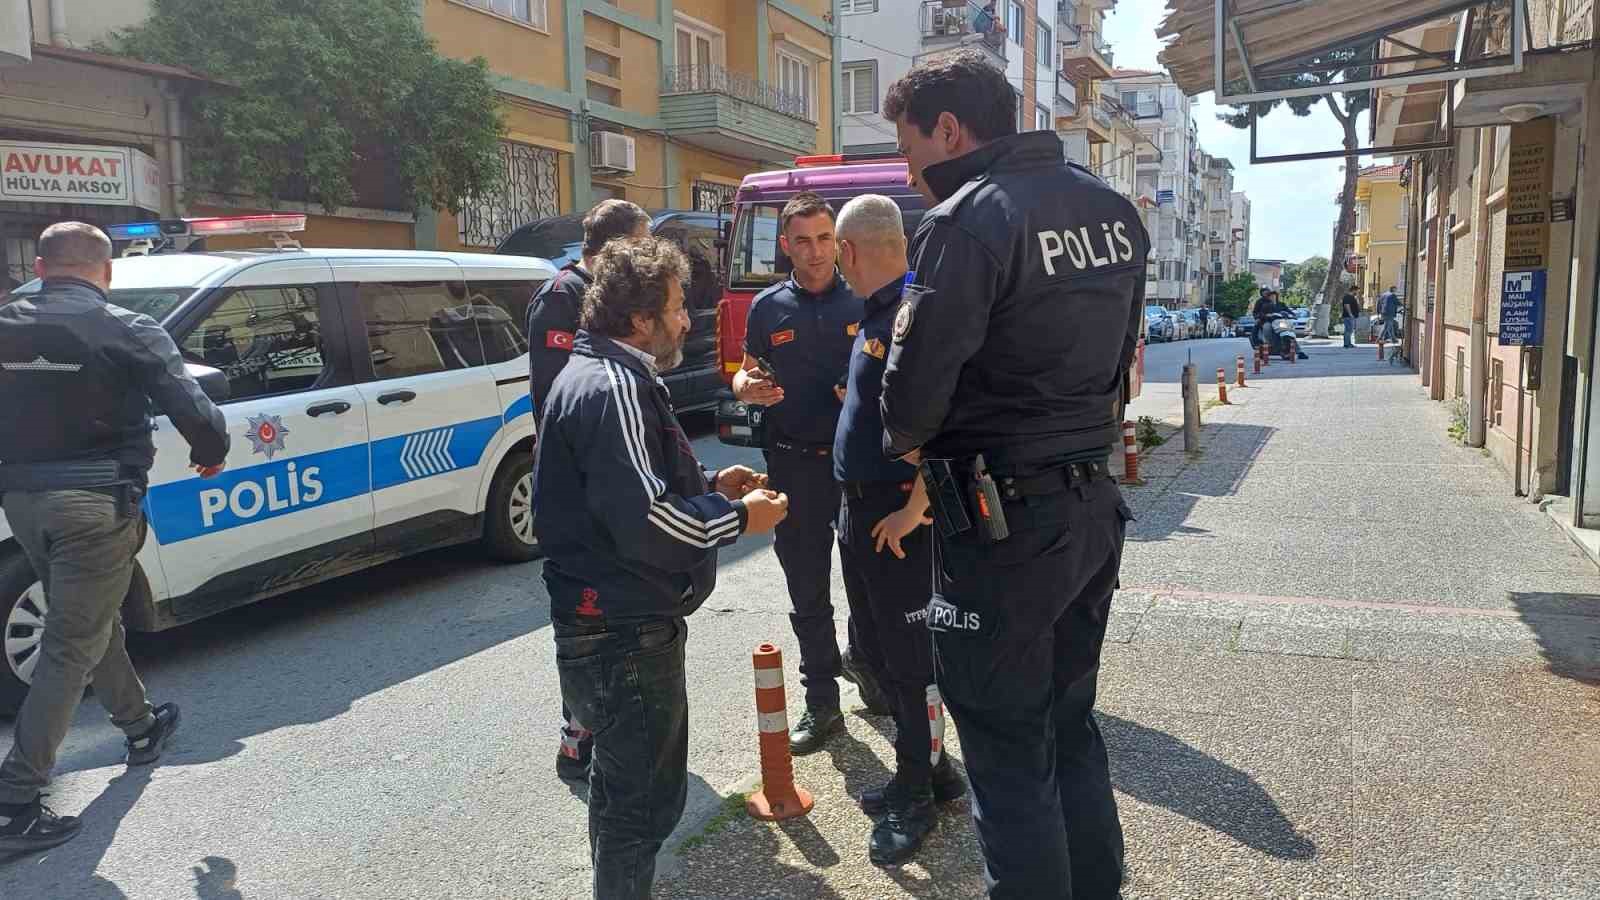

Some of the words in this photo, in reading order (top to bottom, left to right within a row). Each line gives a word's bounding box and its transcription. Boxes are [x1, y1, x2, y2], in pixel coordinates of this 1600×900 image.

[4, 152, 121, 177] AVUKAT
[6, 175, 62, 192] HÜLYA
[66, 180, 122, 194] AKSOY
[200, 461, 324, 528] POLİS
